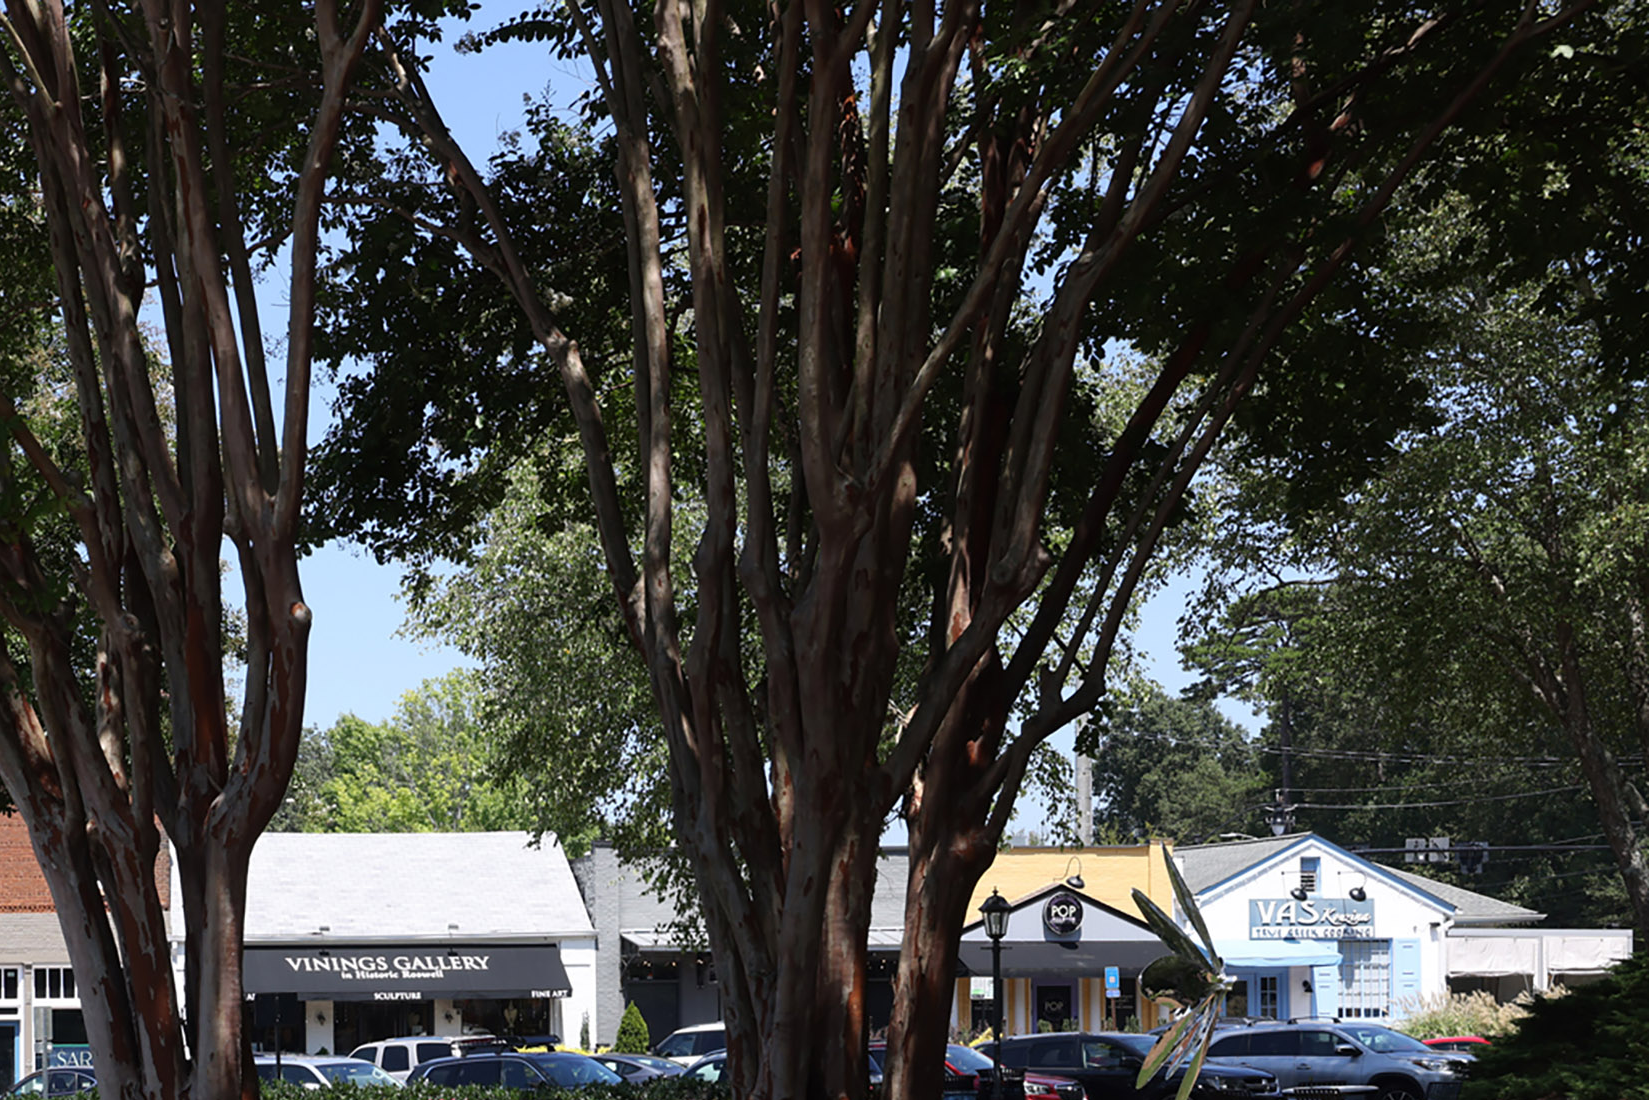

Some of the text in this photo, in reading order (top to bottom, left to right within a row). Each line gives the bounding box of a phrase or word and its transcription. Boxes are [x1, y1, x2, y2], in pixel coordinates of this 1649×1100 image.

[1051, 904, 1077, 918] POP
[1256, 900, 1320, 925] VAS
[285, 955, 490, 972] VININGS GALLERY
[373, 992, 422, 1001] SCULPTURE
[530, 989, 568, 999] FINE ART
